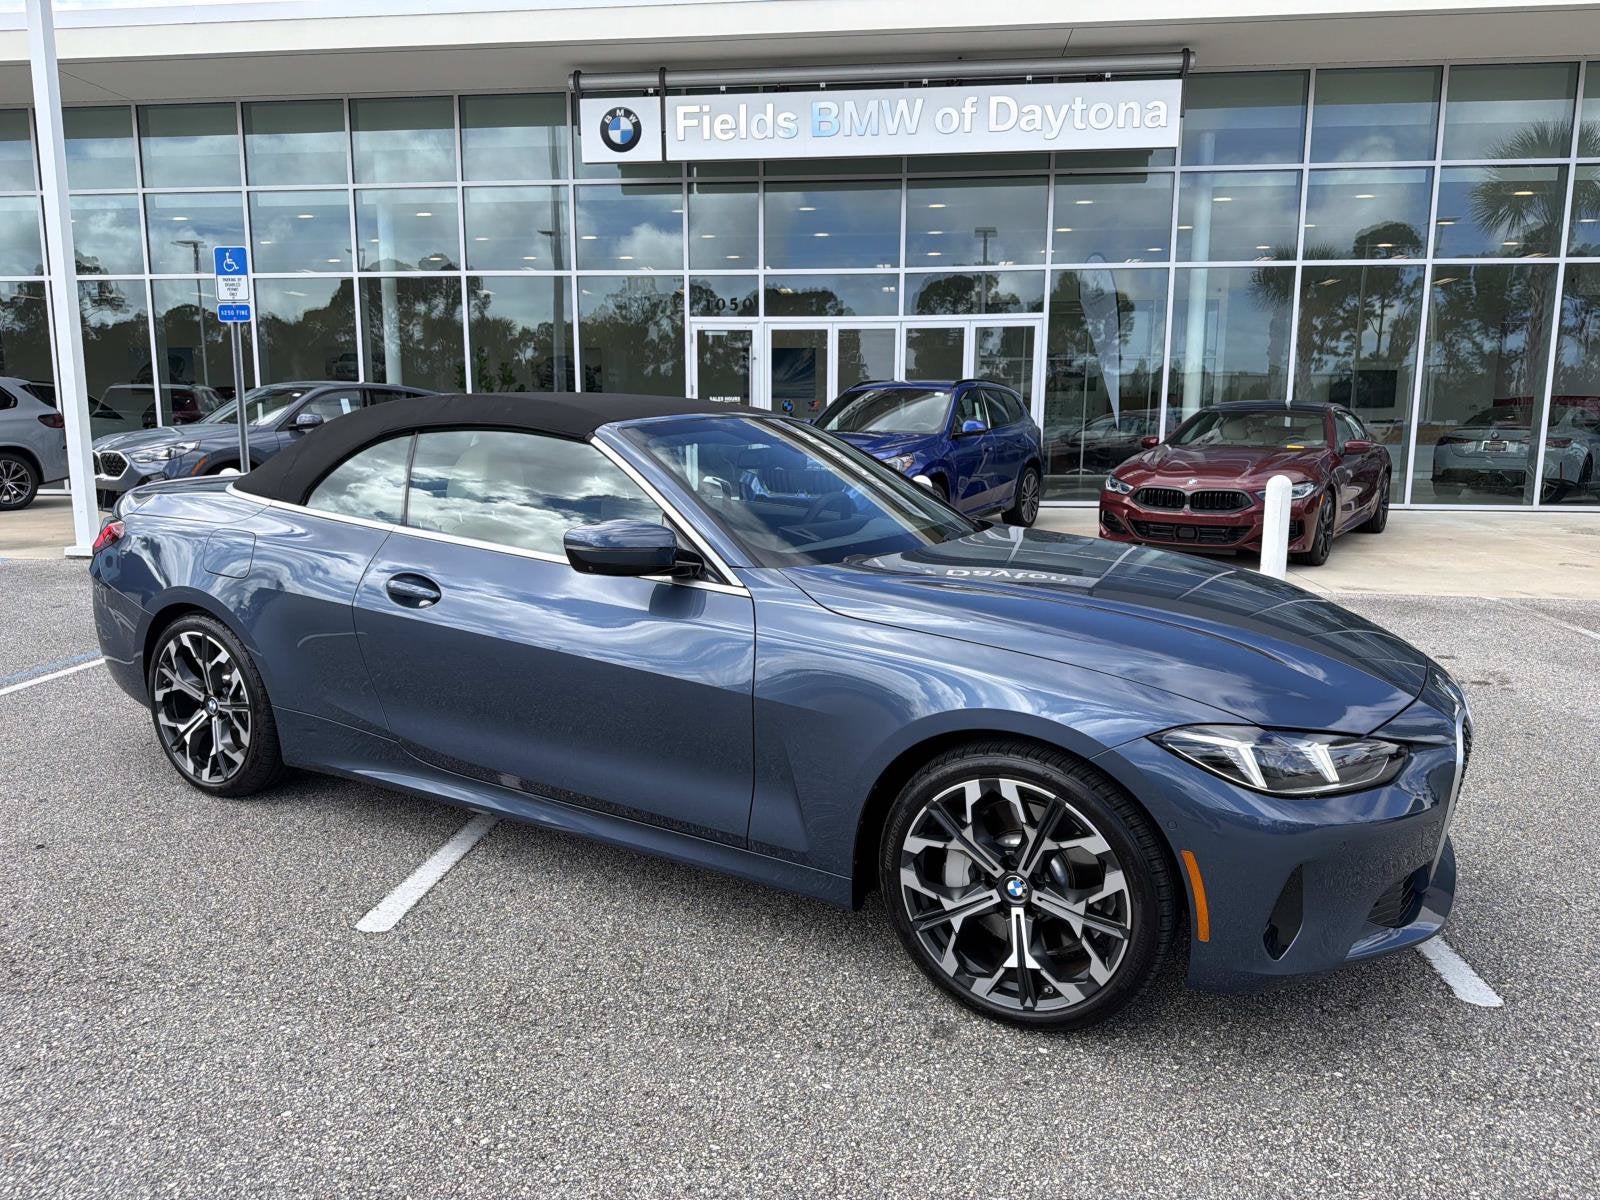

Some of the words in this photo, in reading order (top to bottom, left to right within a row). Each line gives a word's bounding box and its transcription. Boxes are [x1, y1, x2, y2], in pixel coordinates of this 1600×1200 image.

[604, 109, 638, 124] BMW
[676, 103, 799, 142] Fields
[811, 98, 924, 138] BMW
[934, 96, 978, 134] of
[988, 95, 1168, 140] Daytona
[706, 297, 754, 311] 1050
